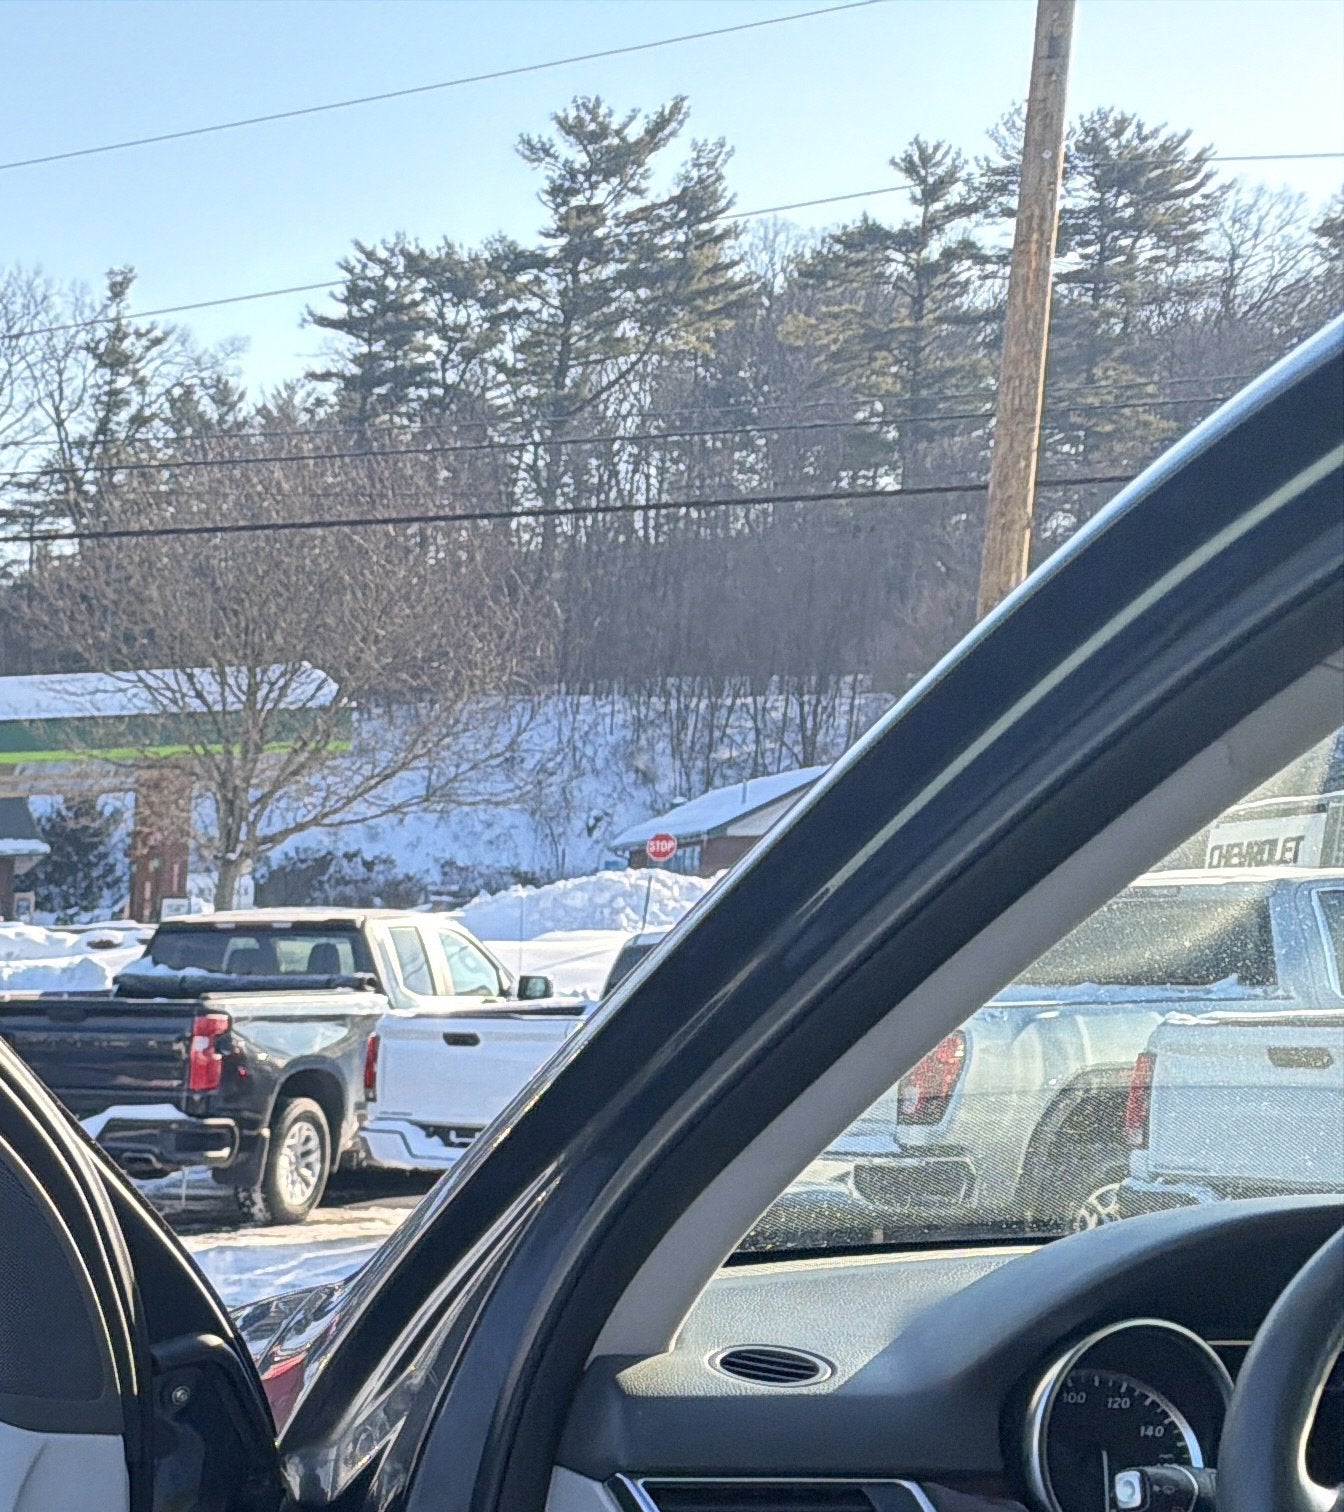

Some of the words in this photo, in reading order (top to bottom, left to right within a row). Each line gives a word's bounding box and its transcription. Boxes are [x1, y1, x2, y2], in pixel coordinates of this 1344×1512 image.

[649, 839, 675, 852] STOP
[1063, 1391, 1087, 1404] 100
[1107, 1397, 1131, 1409] 120
[1139, 1425, 1165, 1437] 140
